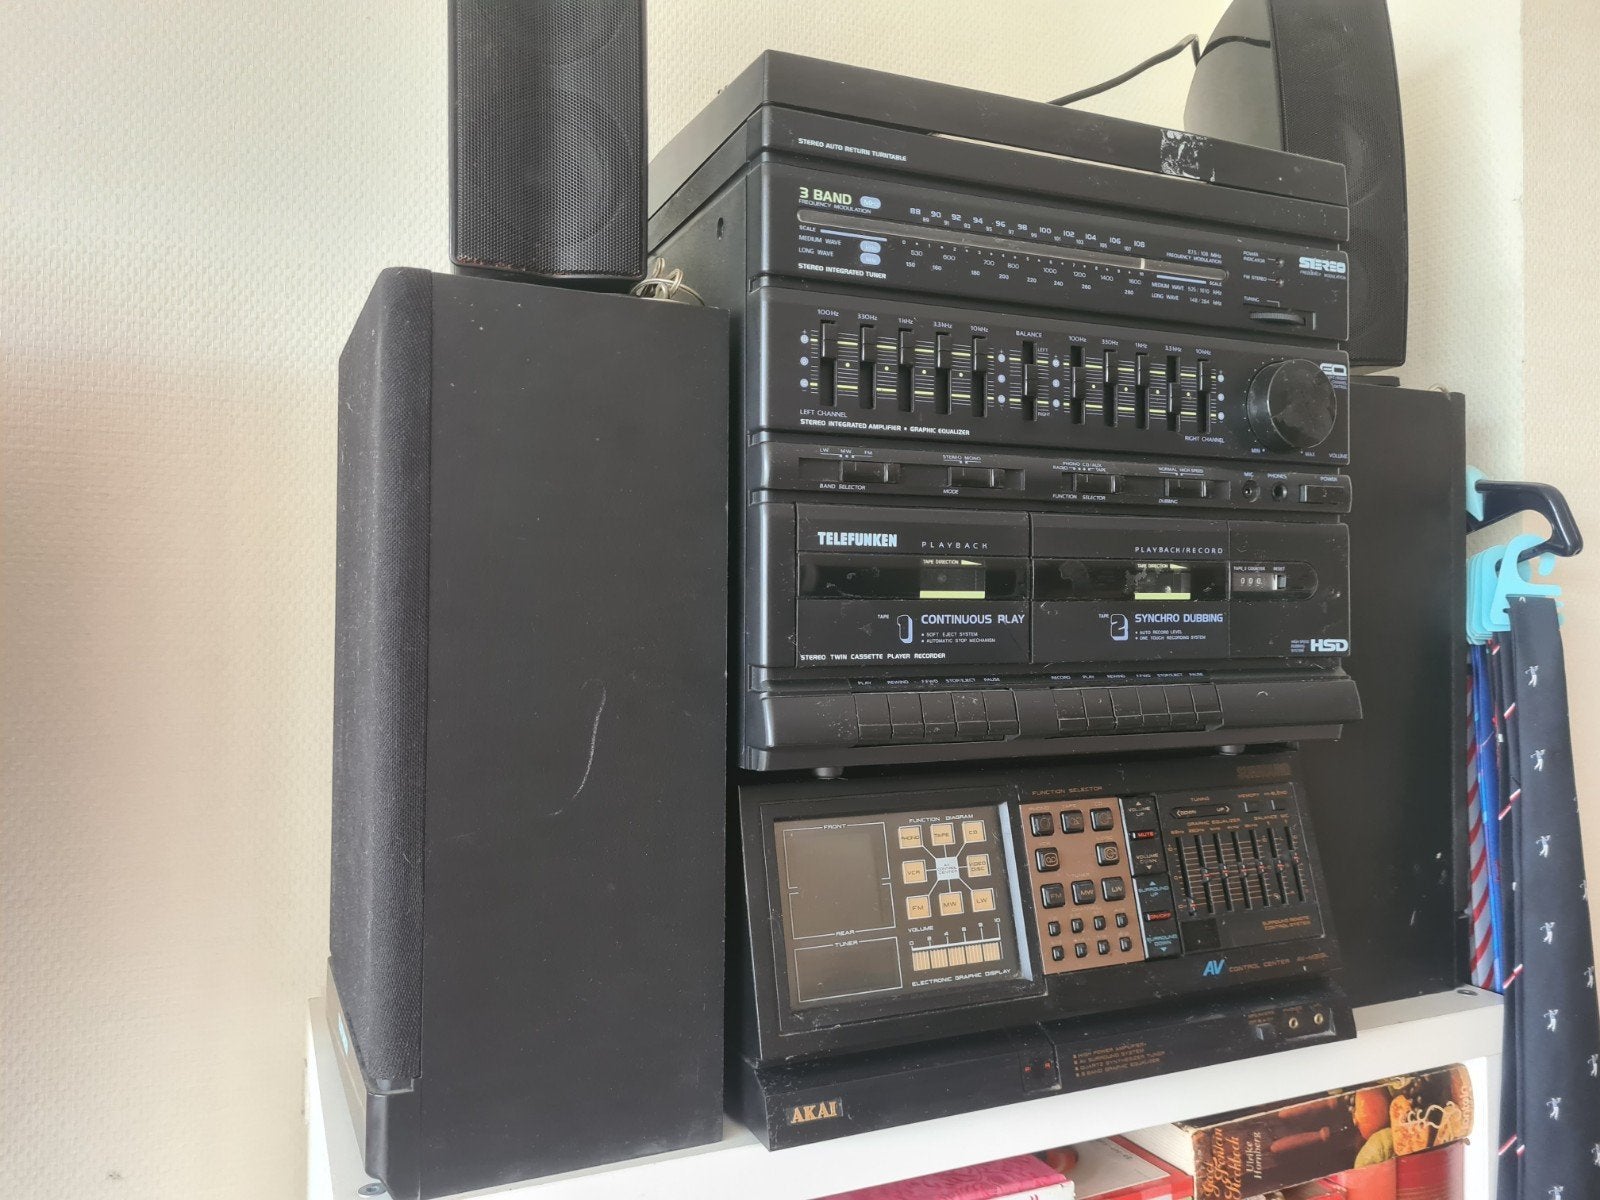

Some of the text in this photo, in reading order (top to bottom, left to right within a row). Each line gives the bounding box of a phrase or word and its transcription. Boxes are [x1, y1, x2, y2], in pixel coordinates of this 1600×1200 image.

[798, 138, 907, 162] STEREO AUTO RETURN TURNTABLE
[799, 187, 809, 199] 3
[813, 188, 852, 205] BAND
[798, 199, 872, 214] FREQUENCY MODULATION
[799, 225, 817, 233] SCALE
[910, 207, 921, 215] 88
[930, 210, 942, 218] 90
[951, 213, 962, 221] 92
[972, 216, 984, 225] 94
[995, 220, 1006, 228] 96
[1017, 223, 1028, 231] 98
[1063, 230, 1075, 238] 102
[1085, 233, 1097, 241] 104
[1110, 237, 1121, 245] 106
[1133, 240, 1146, 248] 108
[798, 235, 842, 246] MEDIUM WAVE
[817, 249, 834, 257] WAVE
[1193, 255, 1222, 265] MODULATION
[798, 263, 887, 279] STEREO INTEGRATED TUNER
[1298, 256, 1346, 274] STEREO
[1151, 292, 1165, 300] LONG
[817, 309, 839, 317] 100Hz
[857, 313, 878, 321] 330Hz
[1015, 330, 1042, 338] BALANCE
[799, 408, 848, 418] LEFT CHANNEL
[800, 418, 970, 436] STEREO INTEGRATED AMPLIFIER GRAPHIC EQUALIZER
[1201, 436, 1225, 444] CHANNEL
[817, 531, 898, 547] TELEFUNKEN
[921, 541, 988, 549] PLAYBACK
[1134, 546, 1224, 554] PLAYBACK/RECORD
[920, 614, 992, 624] CONTINUOUS
[1134, 613, 1223, 623] SYNCHRO DUBBING
[1310, 639, 1349, 652] HSD
[907, 925, 934, 933] VOLUME
[834, 939, 858, 947] TUNER
[1203, 959, 1225, 976] AV
[1229, 958, 1291, 973] CONTROL CENTER
[912, 969, 1011, 987] ELECTRONIC GRAPHIC DISPLAY
[791, 1101, 837, 1123] AKAI
[1245, 1141, 1255, 1172] Ulrike
[1252, 1131, 1263, 1180] Hornberg
